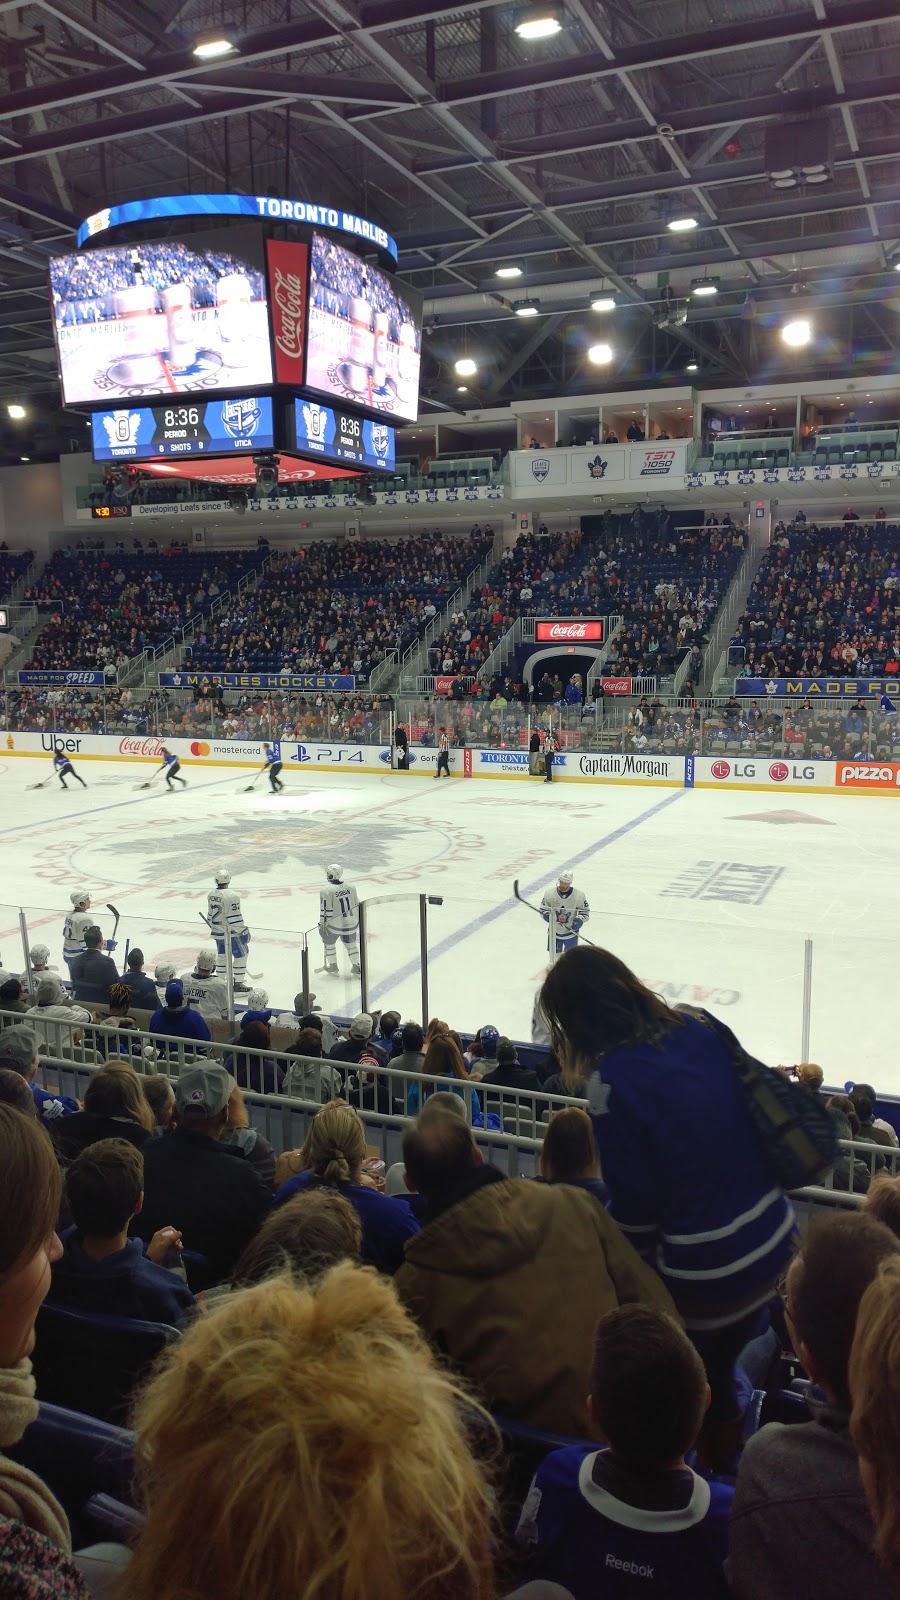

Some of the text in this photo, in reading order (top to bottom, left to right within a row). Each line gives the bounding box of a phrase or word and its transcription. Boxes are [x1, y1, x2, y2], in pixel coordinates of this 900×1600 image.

[256, 197, 389, 248] TORONTO MARLIES
[275, 266, 302, 358] Coca-Cola
[164, 408, 199, 426] 8:36
[340, 416, 360, 436] 8:36
[164, 430, 187, 439] PERIOD
[170, 443, 191, 452] SHOTS
[198, 441, 204, 449] 9
[234, 439, 252, 447] UTICA
[111, 447, 137, 456] TORONTO
[645, 451, 676, 461] TSN
[647, 460, 673, 468] 1050
[139, 504, 179, 514] Developing
[180, 503, 200, 511] Leafs
[201, 502, 222, 510] since
[550, 623, 587, 638] Coca-Cola
[65, 672, 96, 684] SPEED
[267, 678, 338, 687] HOCKEY
[603, 682, 629, 691] Coca-Cola
[787, 682, 857, 693] MADE
[41, 733, 82, 752] Uber
[119, 736, 167, 756] Coca-Cola
[213, 746, 261, 755] mastercard
[316, 749, 365, 763] PS4
[579, 755, 670, 777] Captain Morgan
[734, 764, 756, 777] LG
[792, 766, 815, 780] LG
[841, 766, 893, 784] pizza
[338, 896, 354, 918] 11
[605, 1553, 655, 1580] Reebok
